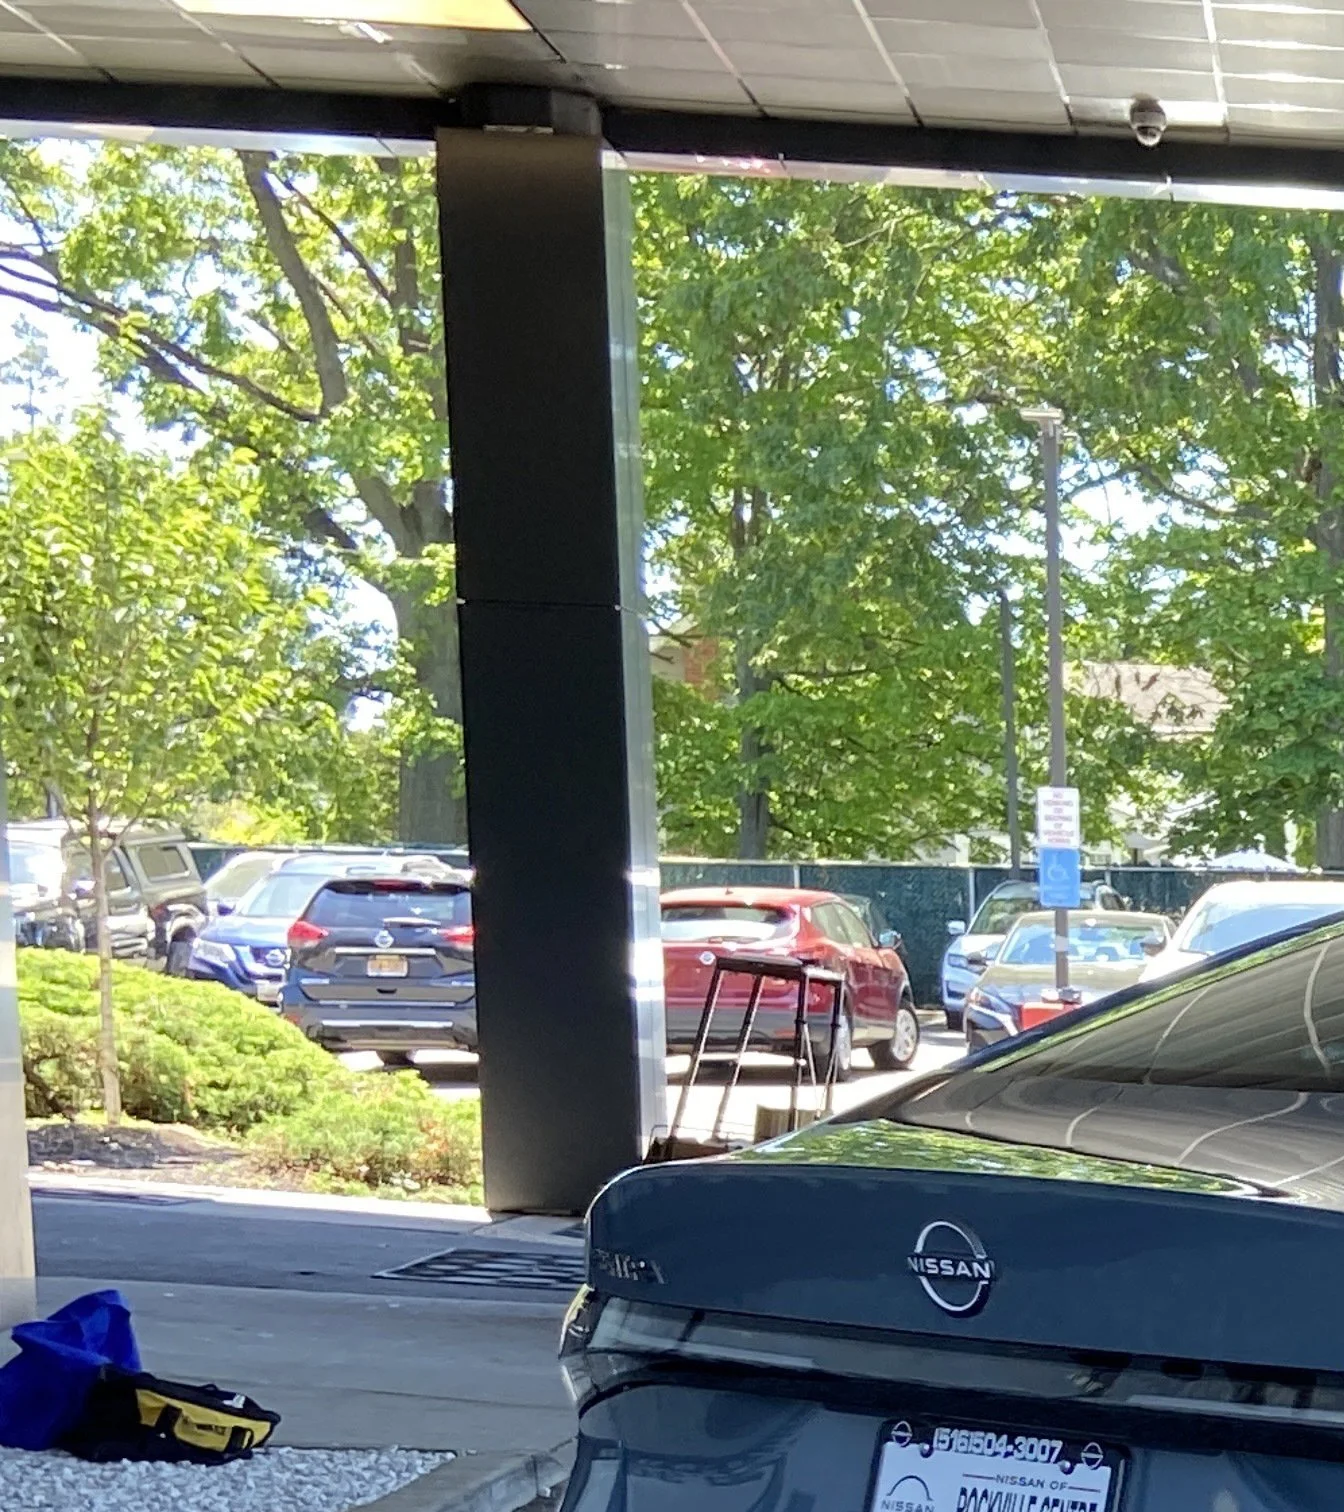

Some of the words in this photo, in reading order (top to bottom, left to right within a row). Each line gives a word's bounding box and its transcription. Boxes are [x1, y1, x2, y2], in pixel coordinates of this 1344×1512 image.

[907, 1256, 992, 1279] NISSAN
[995, 1474, 1046, 1490] NISSAN
[1049, 1480, 1069, 1491] OF
